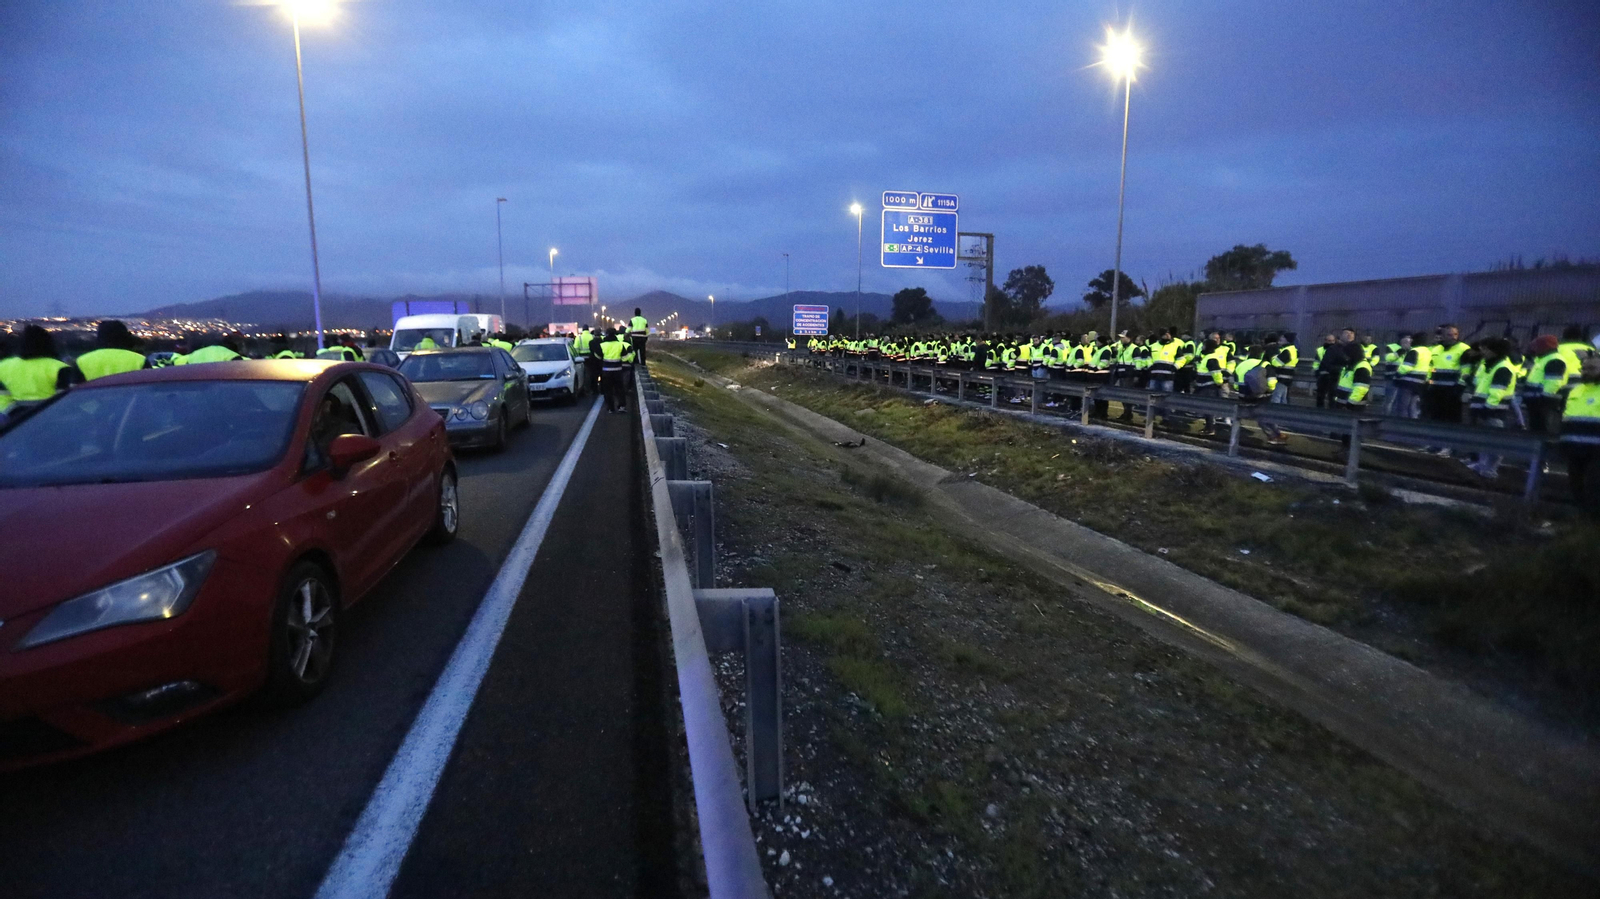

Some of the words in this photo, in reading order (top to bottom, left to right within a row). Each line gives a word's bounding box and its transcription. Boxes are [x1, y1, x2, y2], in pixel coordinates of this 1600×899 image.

[914, 225, 947, 234] Barrios
[908, 235, 933, 243] Jerez
[924, 246, 954, 254] Sevilla
